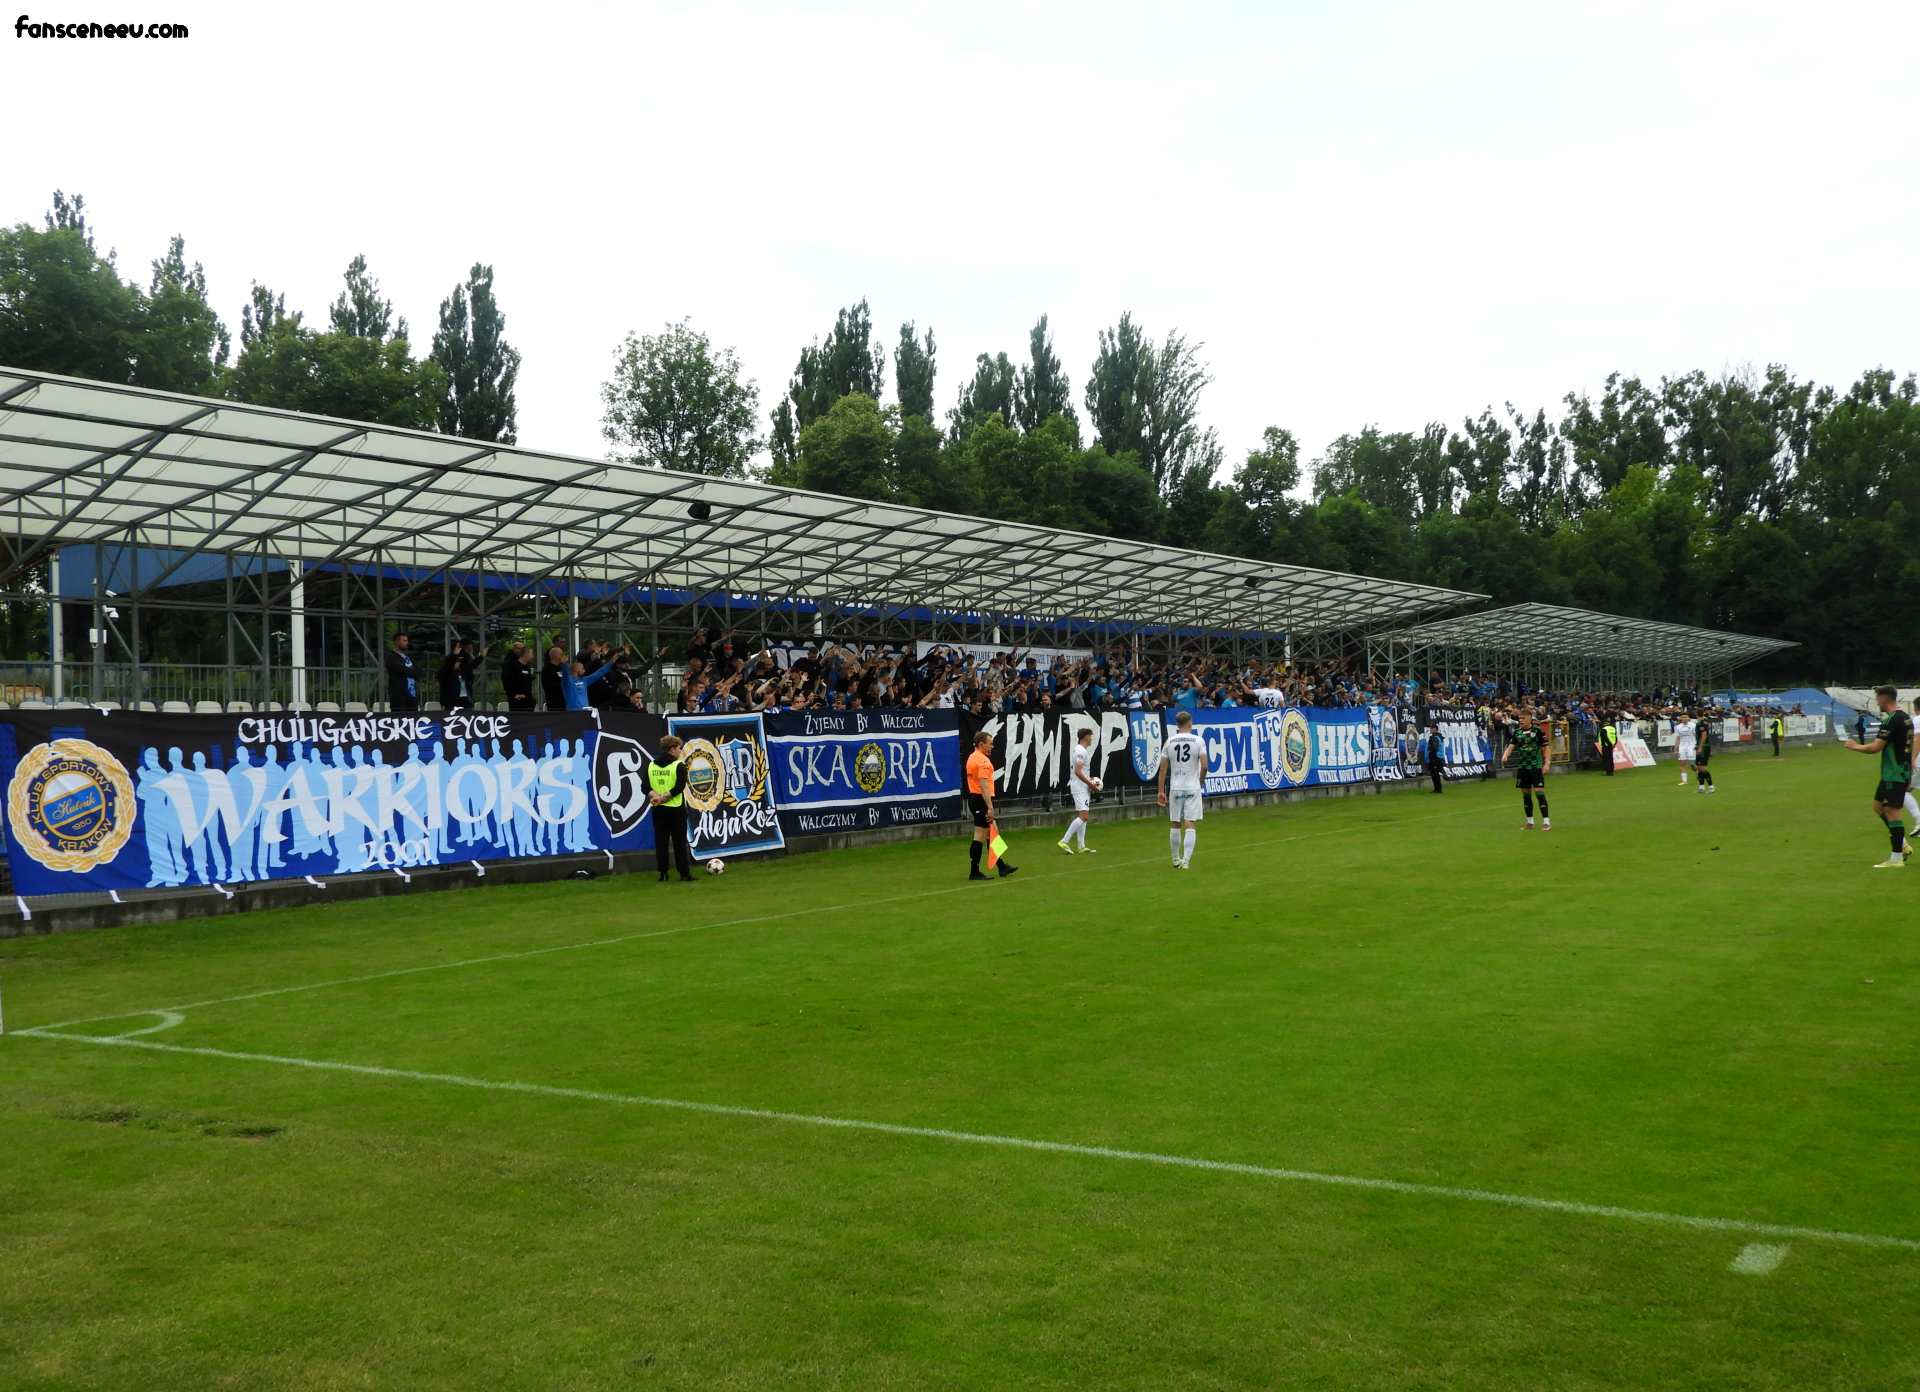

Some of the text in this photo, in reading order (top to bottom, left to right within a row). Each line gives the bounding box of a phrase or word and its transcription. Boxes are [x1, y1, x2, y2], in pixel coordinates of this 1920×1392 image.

[238, 711, 512, 745] CHULIGAŃSKIE ŻYCIE
[804, 712, 846, 735] ŻYJEMY
[881, 713, 925, 729] WALCZYĆ
[1174, 743, 1191, 763] 13
[1176, 726, 1254, 774] CM
[1317, 724, 1369, 766] HKS
[31, 761, 112, 824] KLUB SPORTOWY
[151, 757, 586, 847] WARRIORS
[689, 811, 741, 847] Aleja
[799, 813, 856, 831] WALCZYMY
[891, 804, 938, 822] WYGRYWAĆ
